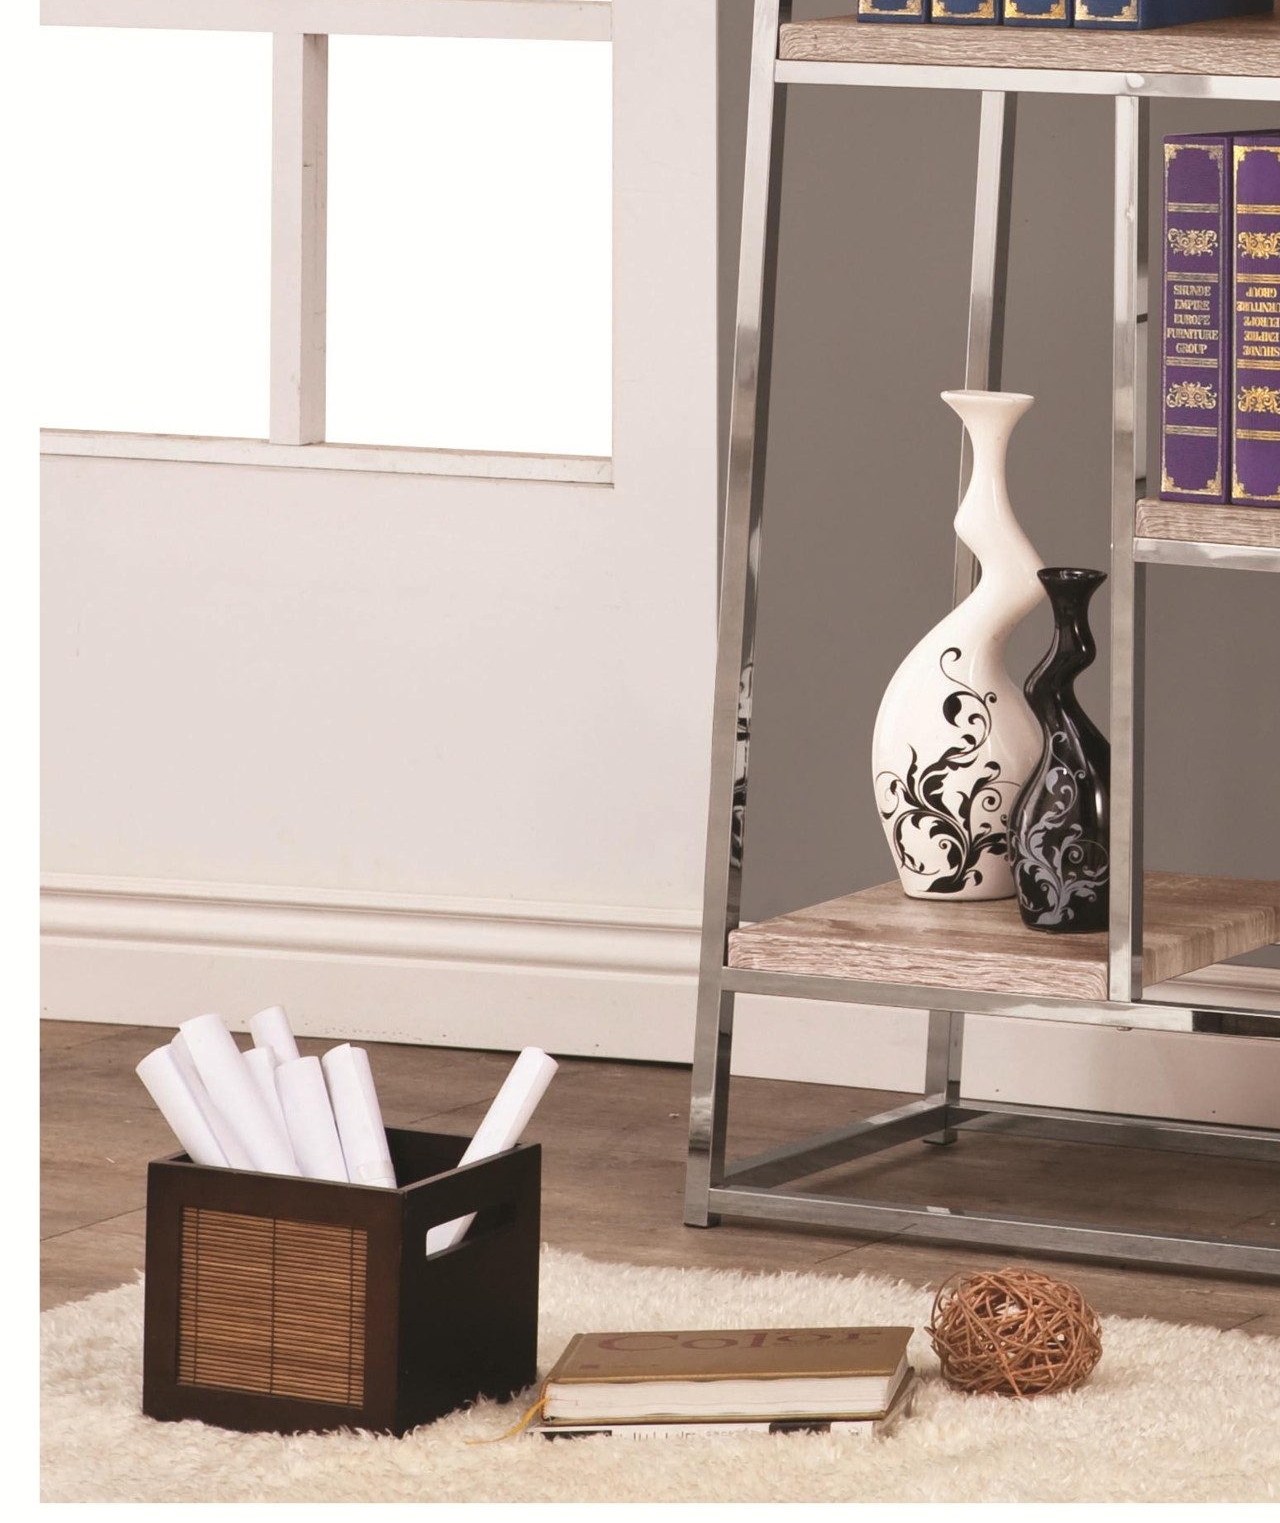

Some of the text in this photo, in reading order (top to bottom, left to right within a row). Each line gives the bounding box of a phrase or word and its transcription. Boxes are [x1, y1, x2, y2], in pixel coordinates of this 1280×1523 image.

[1173, 285, 1212, 297] SHUNDE
[1174, 299, 1210, 311] EMPIRE
[1173, 313, 1211, 326] EUROPE
[1167, 327, 1219, 340] FURNITURE
[1175, 342, 1208, 355] GROUP
[599, 1330, 882, 1352] Color
